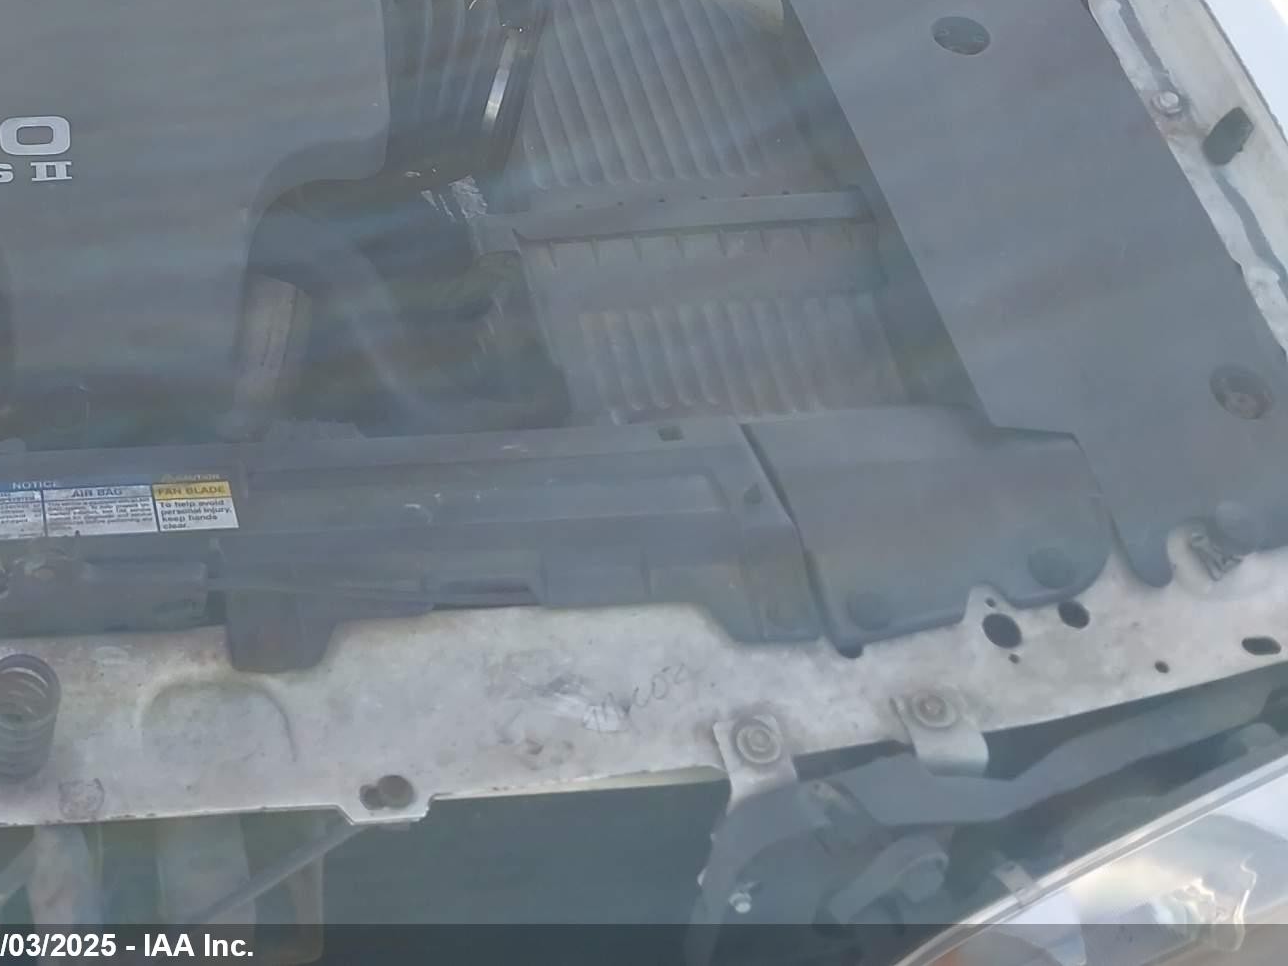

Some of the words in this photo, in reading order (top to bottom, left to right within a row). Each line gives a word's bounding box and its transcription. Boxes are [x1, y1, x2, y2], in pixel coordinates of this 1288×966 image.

[30, 161, 72, 182] II
[12, 481, 56, 490] NOTICE
[158, 488, 182, 496] FAN
[185, 485, 226, 494] BLADE
[71, 489, 93, 498] AIR
[97, 487, 123, 496] BAG
[175, 500, 196, 509] help
